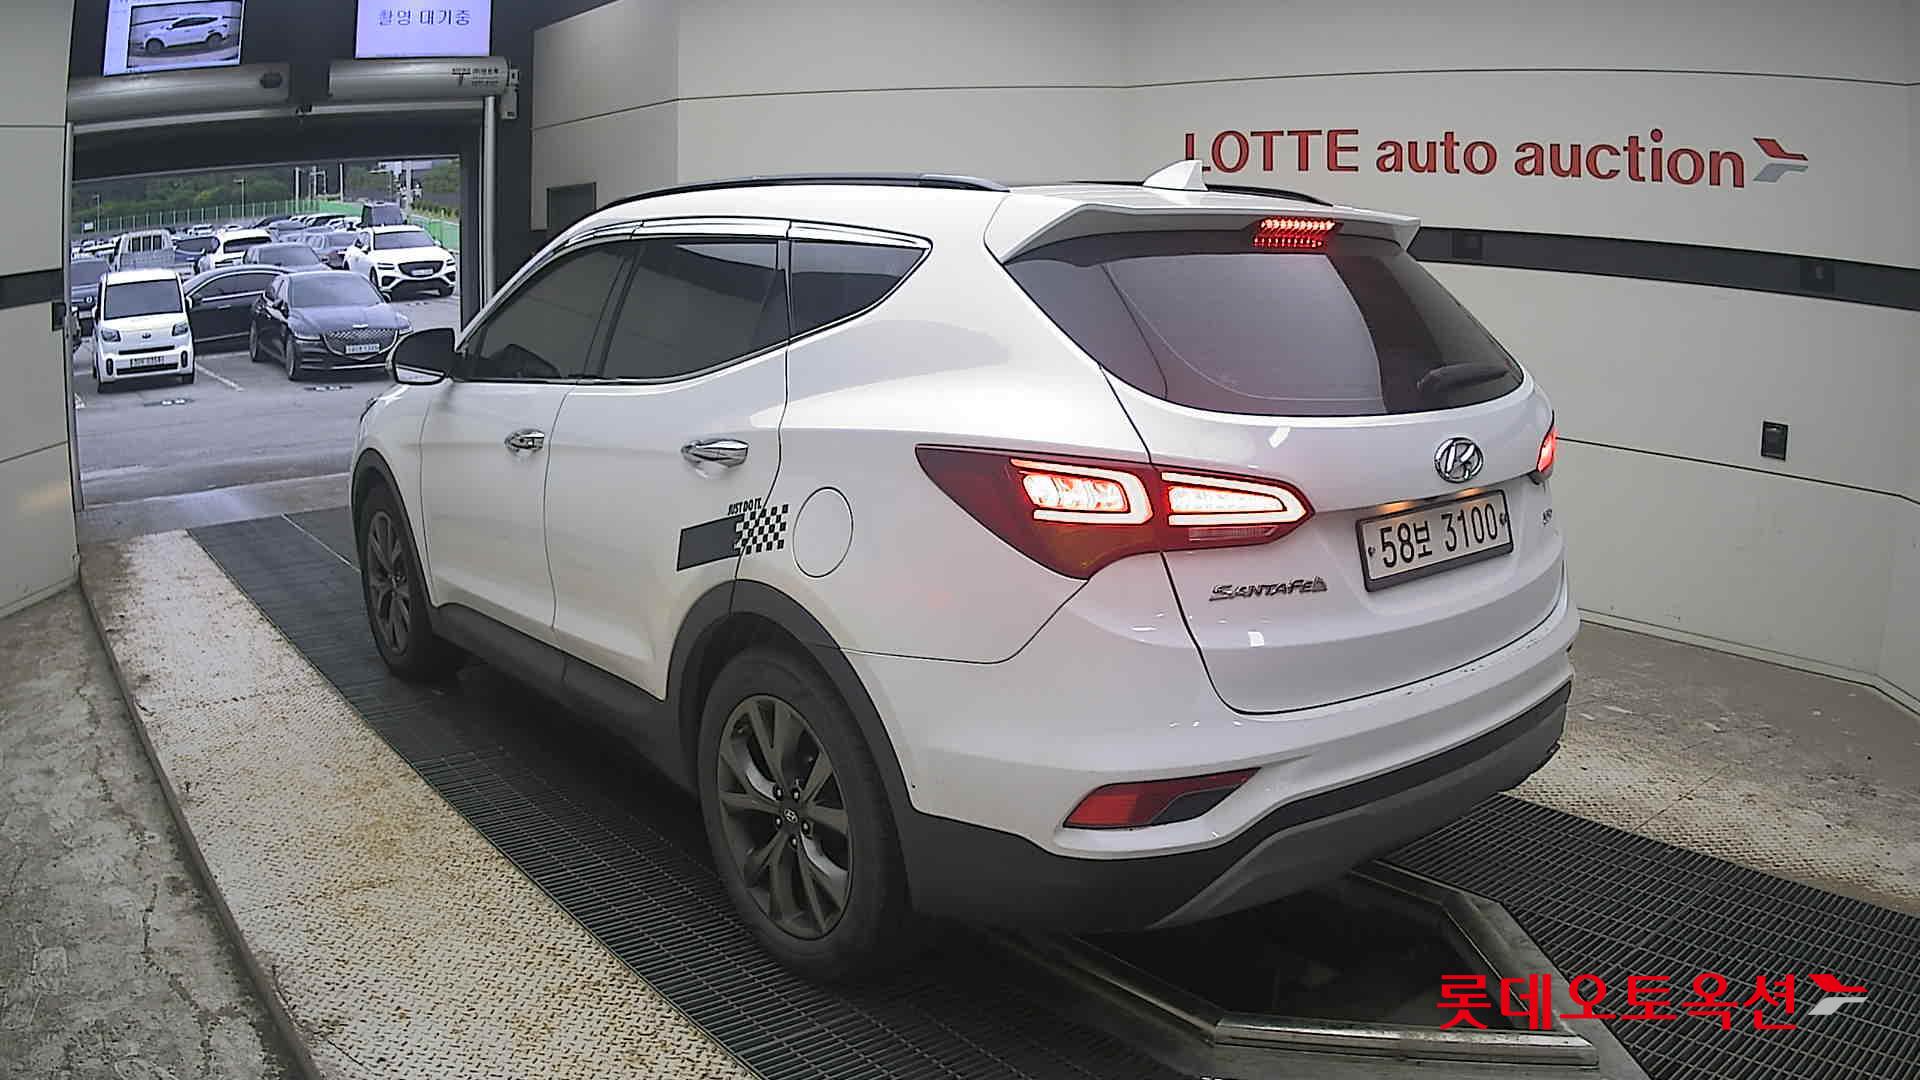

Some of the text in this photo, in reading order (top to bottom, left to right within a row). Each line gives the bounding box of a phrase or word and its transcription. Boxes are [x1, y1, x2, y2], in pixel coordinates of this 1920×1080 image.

[419, 9, 471, 26] 대기중
[1185, 128, 1745, 188] LOTTE auto auction
[1379, 503, 1498, 568] 58보 3100
